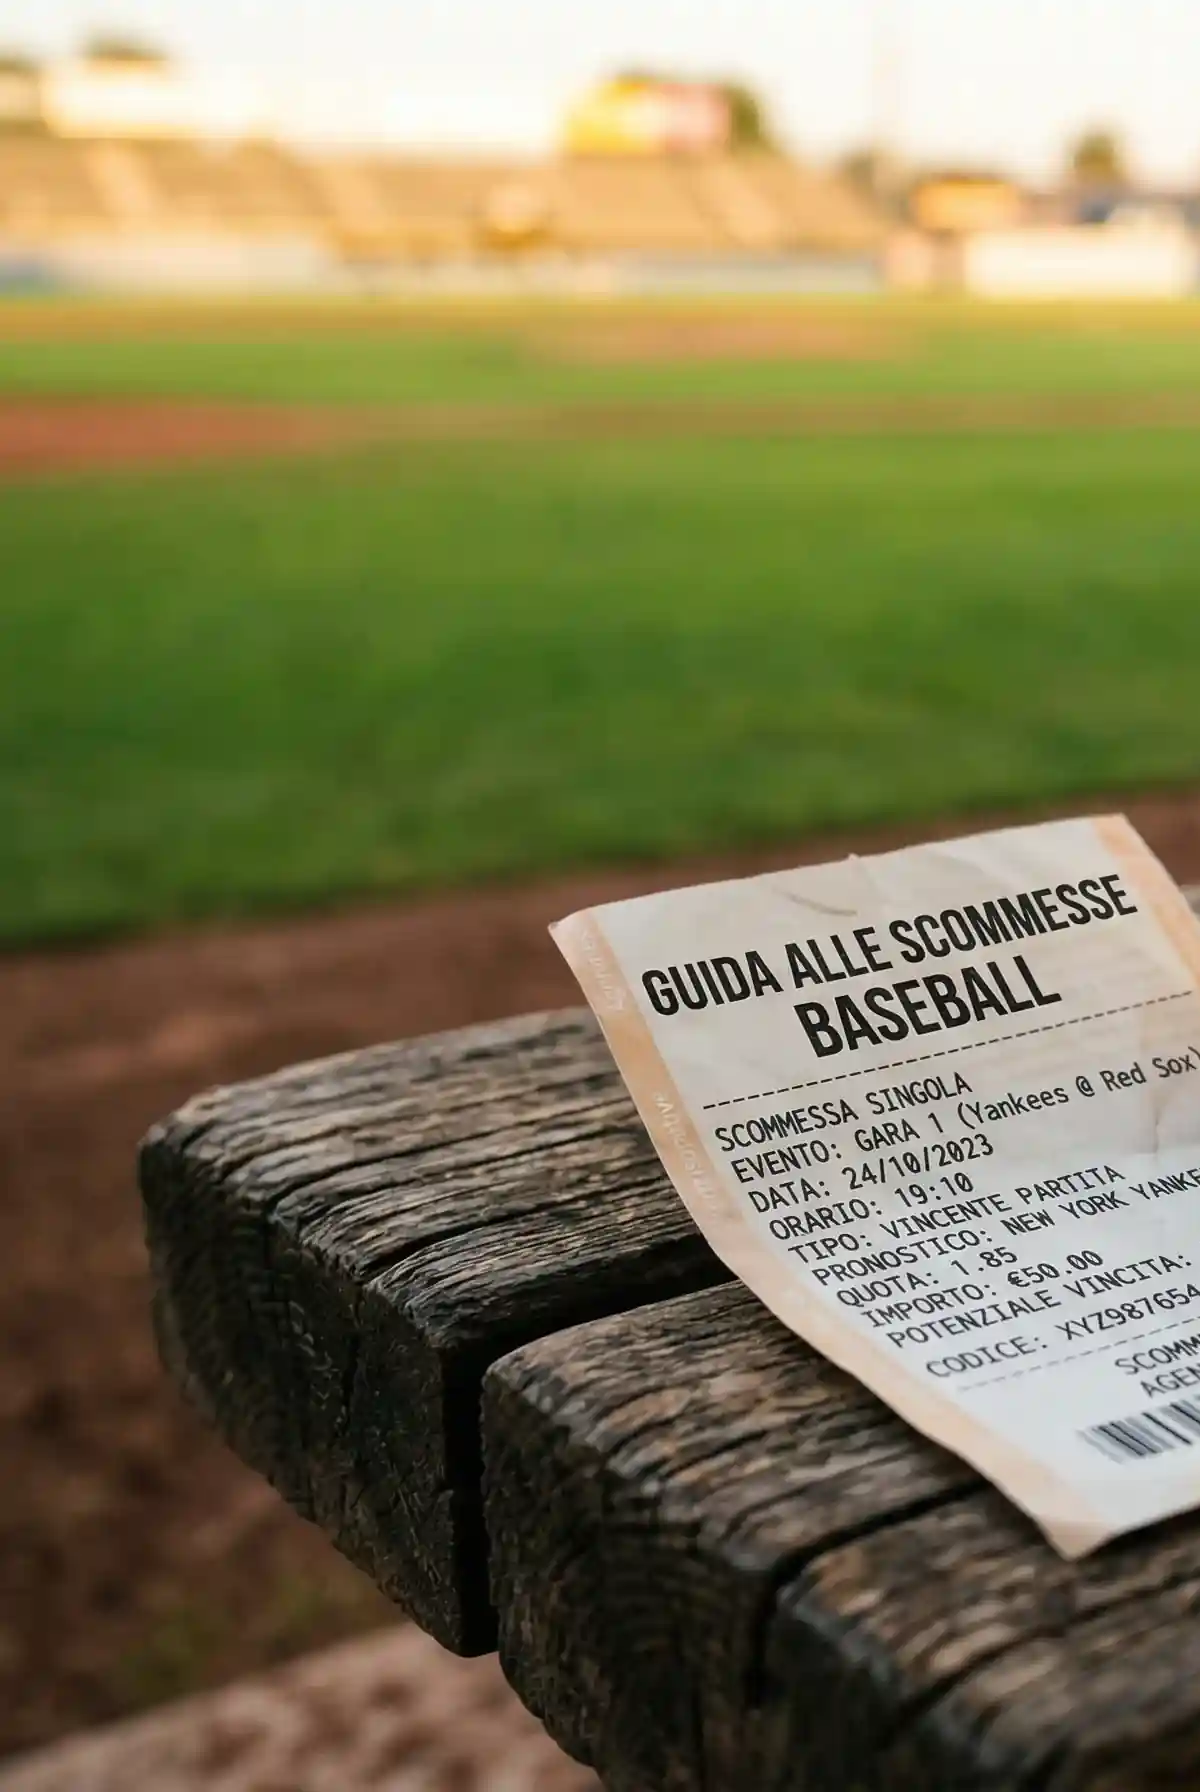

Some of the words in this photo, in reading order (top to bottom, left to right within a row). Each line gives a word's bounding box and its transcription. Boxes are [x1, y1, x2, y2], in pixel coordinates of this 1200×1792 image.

[642, 950, 781, 1017] GUIDA
[784, 927, 893, 989] ALLE
[889, 874, 1138, 965] SCOMMESSE
[794, 955, 1061, 1059] BASEBALL
[715, 1099, 859, 1152] SCOMMESSA
[865, 1072, 973, 1115] SINGOLA
[731, 1139, 842, 1183] EVENTO:
[854, 1118, 920, 1152] GARA
[928, 1112, 944, 1133] 1
[957, 1086, 1069, 1129] (Yankees
[1075, 1075, 1095, 1097] @
[1100, 1062, 1147, 1091] Red
[748, 1177, 830, 1213] DATA:
[841, 1133, 994, 1190] 24/10/2023
[769, 1199, 882, 1240] ORARIO:
[895, 1172, 974, 1207] 19:10
[788, 1233, 872, 1264] TIPO:
[879, 1193, 1012, 1240] VINCENTE
[1015, 1165, 1126, 1205] PARTITA
[812, 1229, 993, 1286] PRONOSTICO:
[1000, 1208, 1056, 1236] NEW
[1058, 1190, 1130, 1219] YORK
[836, 1271, 940, 1308] QUOTA:
[950, 1246, 1018, 1276] 1.85
[860, 1283, 997, 1328] IMPORTO:
[1007, 1250, 1104, 1288] €50.00
[886, 1289, 1062, 1348] POTENZIALE
[1062, 1252, 1193, 1298] VINCITA:
[926, 1335, 1048, 1378] CODICE:
